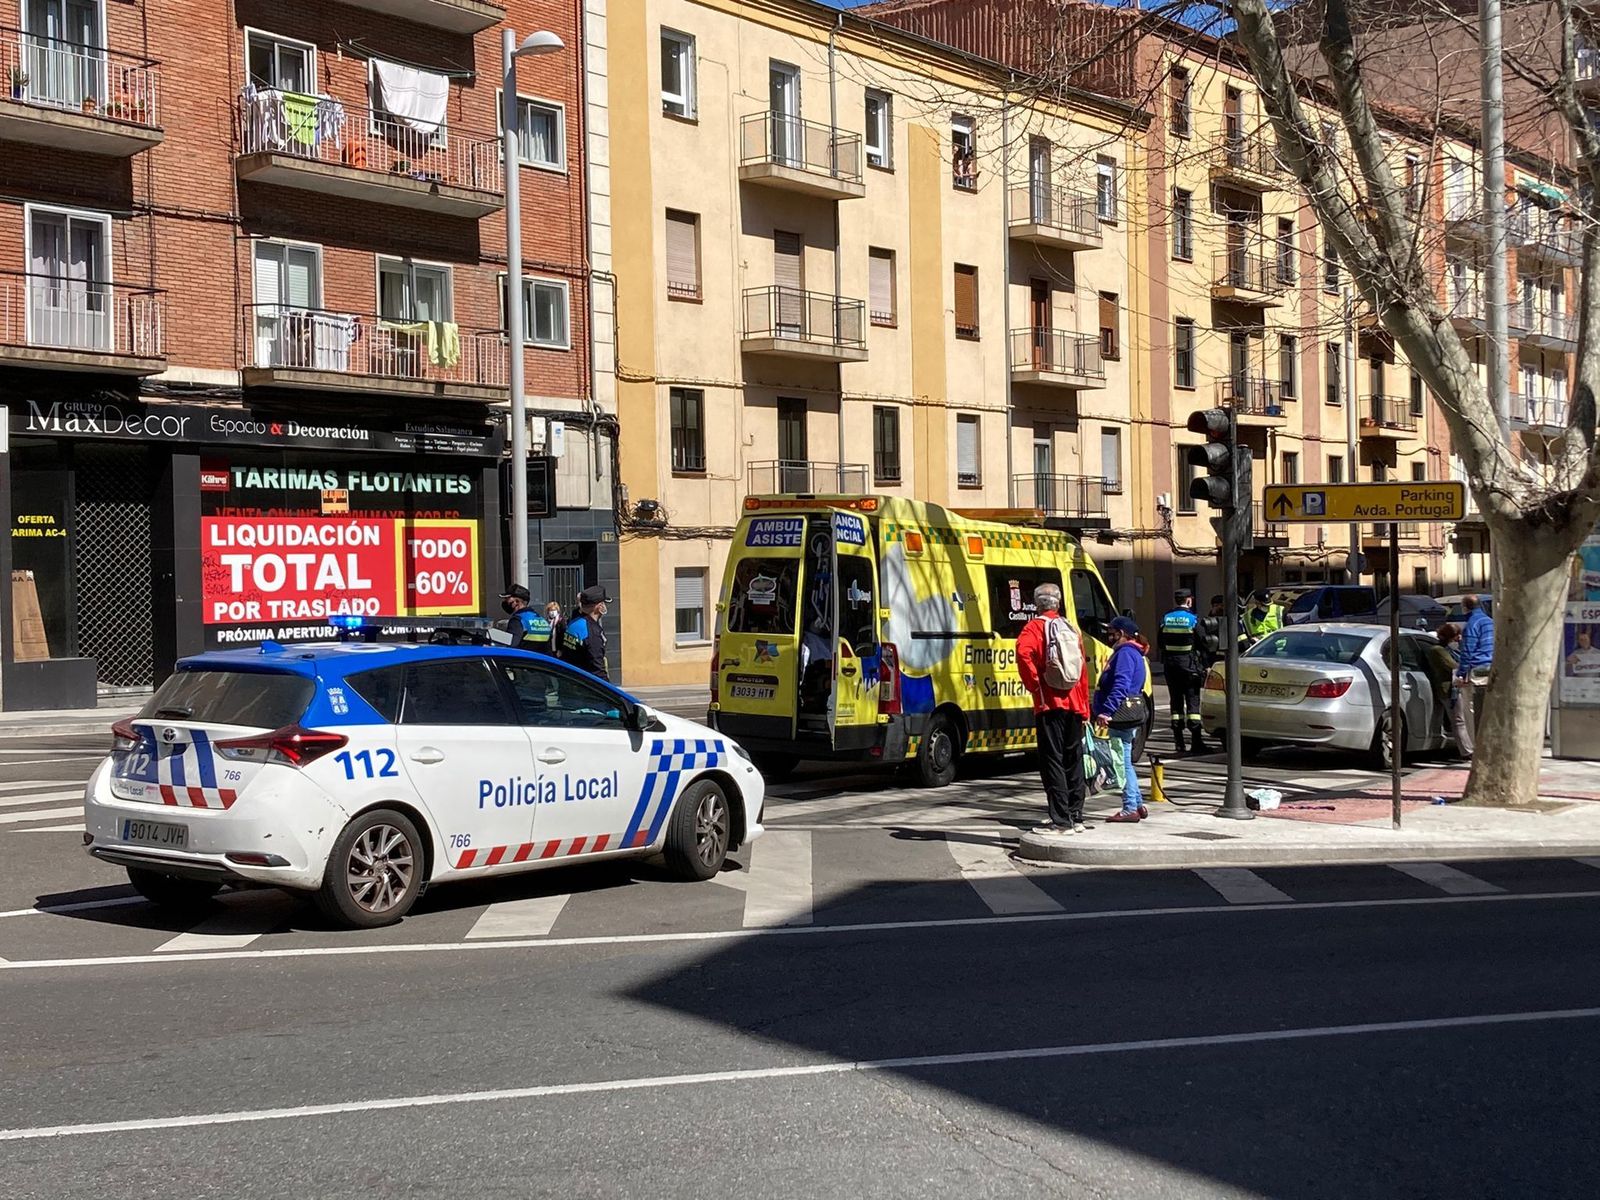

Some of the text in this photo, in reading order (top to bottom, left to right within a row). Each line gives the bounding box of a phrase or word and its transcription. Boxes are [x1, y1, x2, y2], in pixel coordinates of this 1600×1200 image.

[64, 402, 102, 412] GRUPO
[210, 414, 369, 440] Espacio & Decoración
[230, 467, 472, 494] TARIMAS FLOTANTES
[1401, 489, 1454, 504] Parking
[17, 515, 55, 524] OFERTA
[1353, 503, 1455, 518] Avda. Portugal
[44, 528, 67, 537] AC-4
[754, 514, 862, 533] AMBUL ANCIA
[210, 520, 380, 547] LIQUIDACIÓN
[752, 528, 863, 546] ASISTE NCIAL
[408, 539, 468, 558] TODO
[220, 553, 372, 592] TOTAL
[407, 571, 469, 595] -60%
[213, 597, 381, 621] POR TRASLADO
[217, 626, 275, 642] PRÓXIMA
[964, 644, 1018, 670] Emerge
[735, 686, 756, 698] 3033
[333, 747, 399, 781] 112
[224, 769, 242, 781] 766
[478, 770, 619, 809] Policía Local
[130, 822, 185, 846] 9014 JVH
[450, 833, 471, 849] 766
